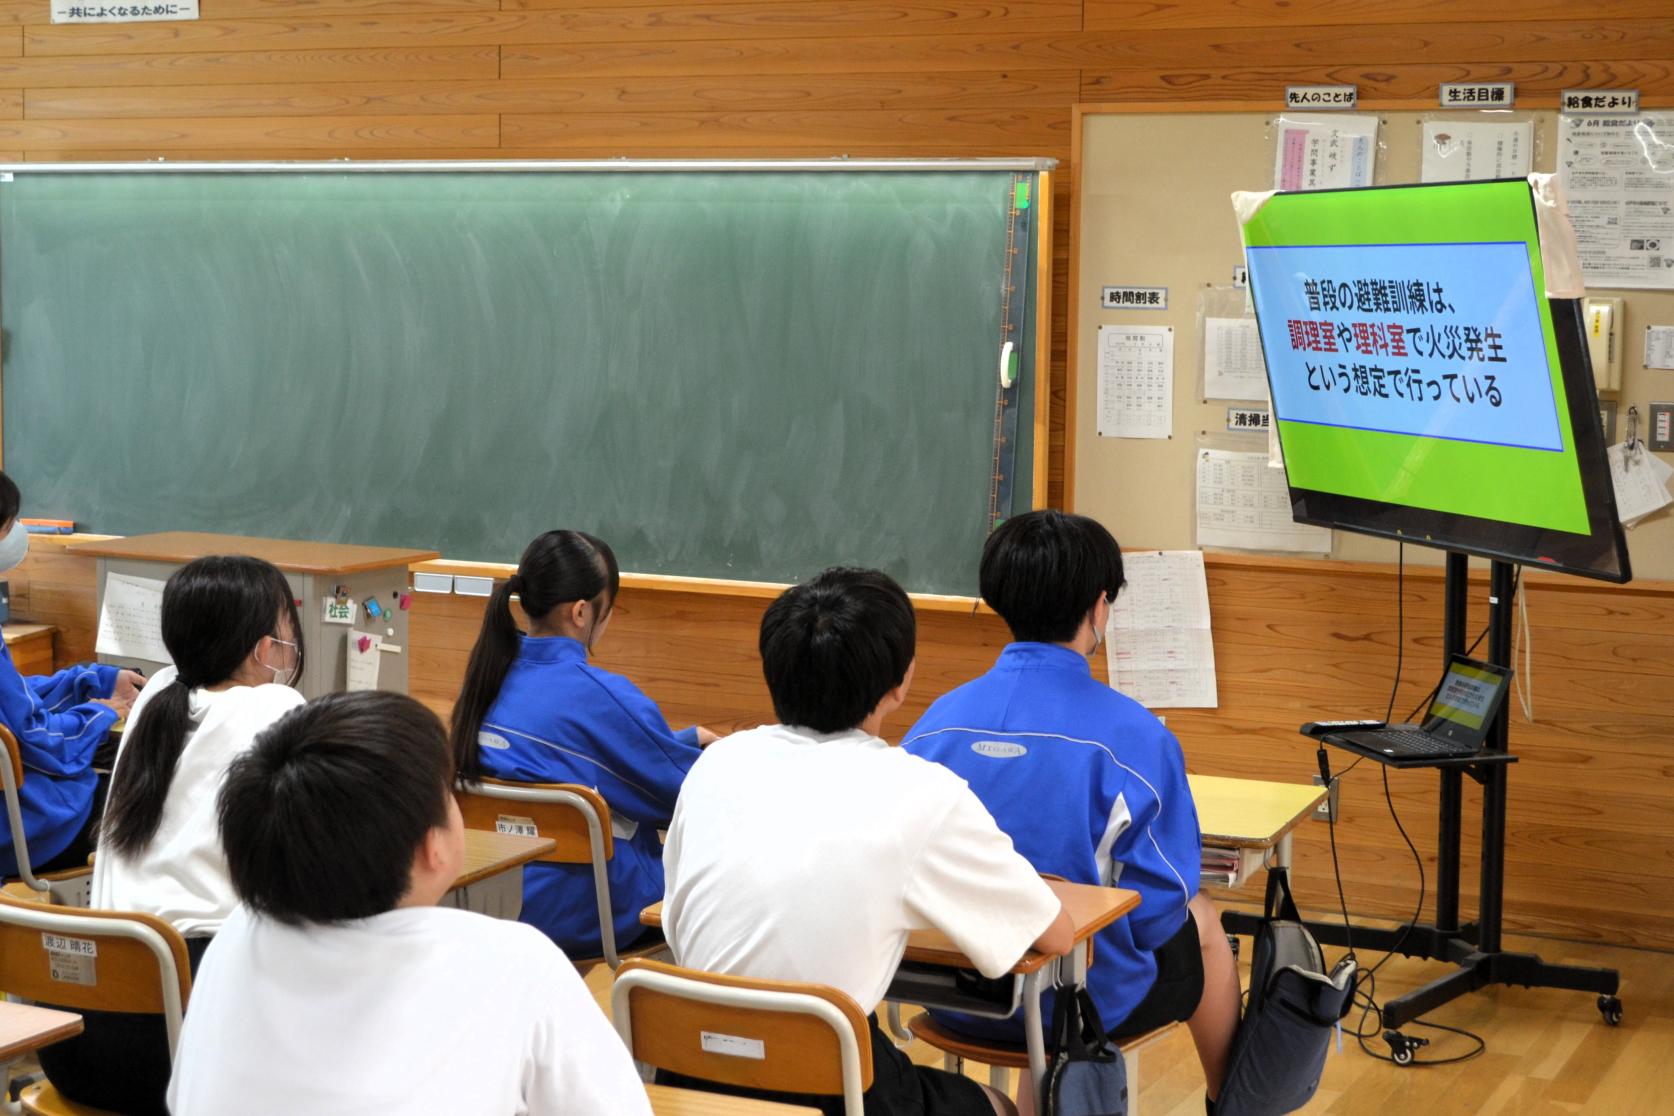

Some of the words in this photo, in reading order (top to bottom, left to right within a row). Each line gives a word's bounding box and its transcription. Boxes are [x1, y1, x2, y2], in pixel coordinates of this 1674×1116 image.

[1289, 92, 1354, 103] 先人のことば
[1448, 87, 1505, 102] 生活目標
[1567, 96, 1632, 109] 給食だより
[1109, 291, 1160, 304] 時間割表
[1304, 278, 1456, 315] 普段の避難訓練は、
[1287, 319, 1507, 363] 調理室や理科室で火災発生
[1305, 361, 1502, 407] という想定で行っている
[329, 603, 349, 619] 社会
